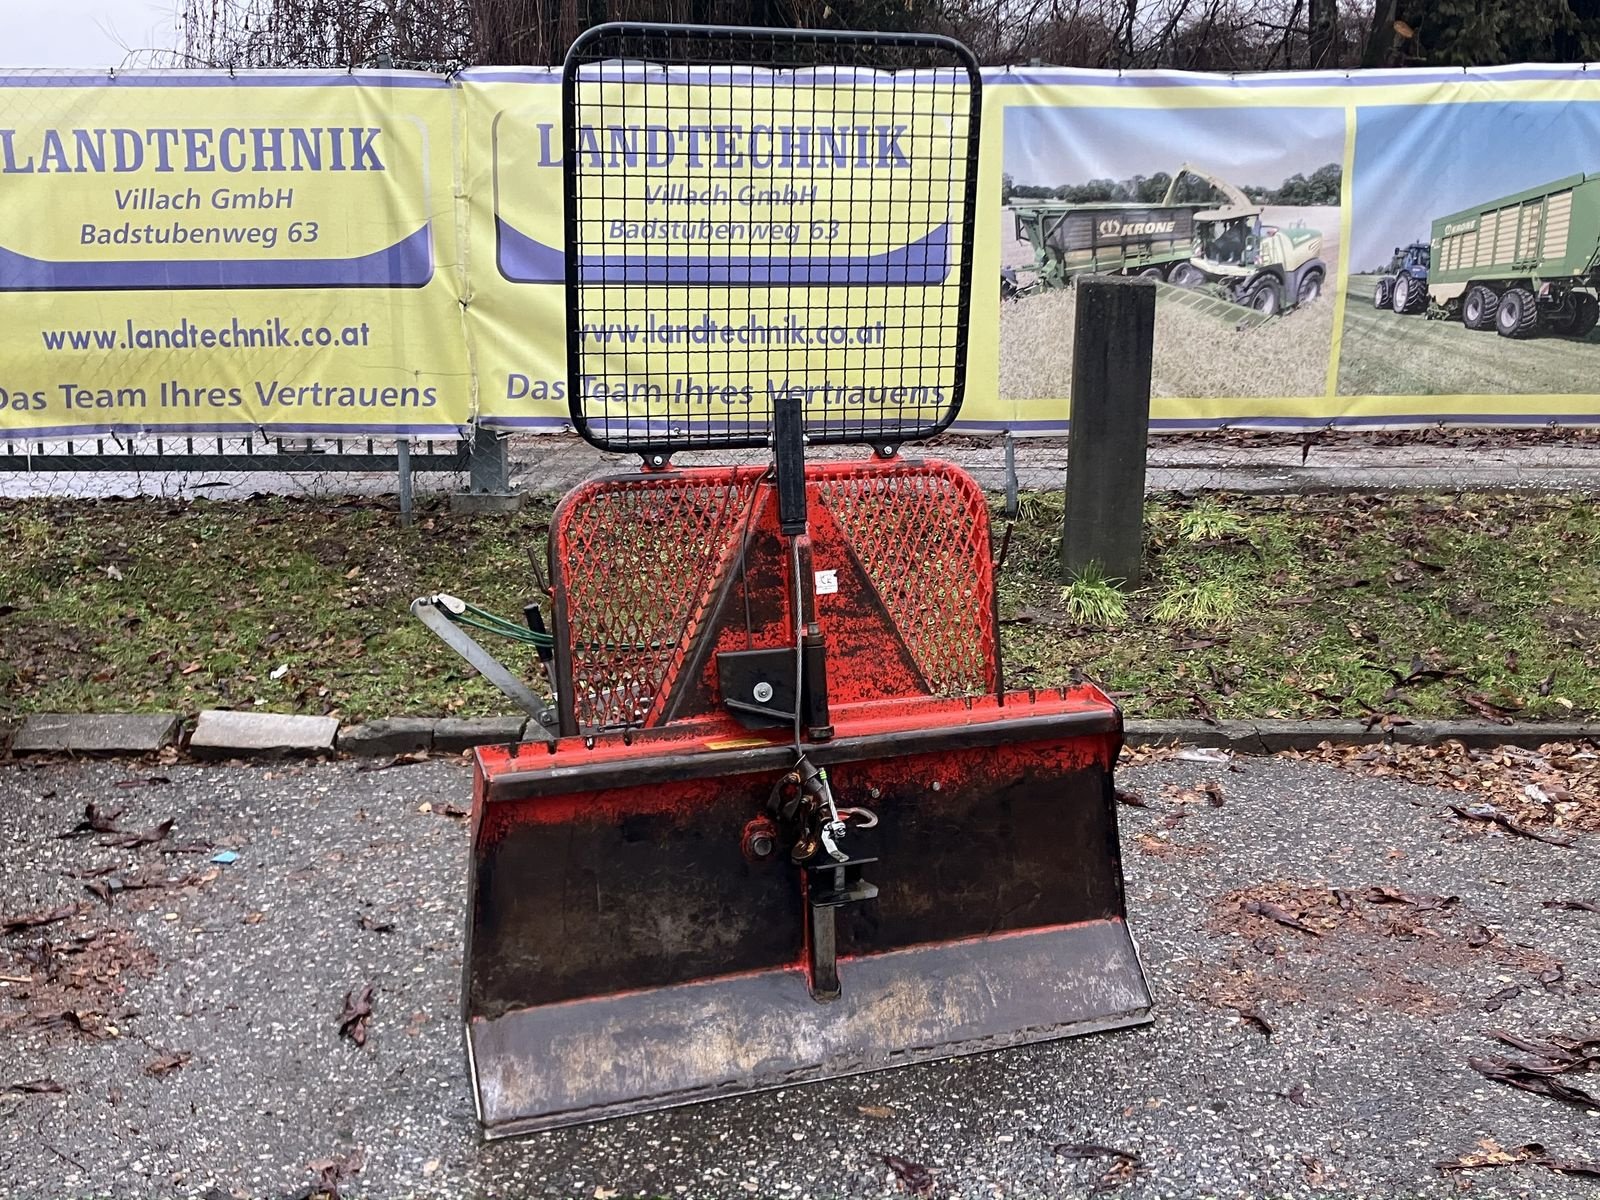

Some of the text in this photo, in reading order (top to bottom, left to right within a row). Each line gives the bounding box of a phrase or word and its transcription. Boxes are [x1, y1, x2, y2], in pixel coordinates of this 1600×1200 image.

[0, 127, 385, 173] LANDTECHNIK
[536, 123, 911, 169] LANDTECHNIK
[114, 188, 293, 210] Villach GmbH
[645, 184, 818, 207] Villach GmbH
[80, 222, 320, 248] Badstubenweg 63
[609, 219, 840, 243] Badstubenweg 63
[1120, 221, 1176, 236] KRONE
[42, 318, 370, 350] www.landtechnik.co.at
[58, 384, 146, 409] Team
[161, 381, 242, 408] Ihres
[255, 381, 437, 407] Vertrauens
[507, 374, 565, 400] Das
[675, 379, 754, 405] Ihres
[768, 379, 945, 405] Vertrauens
